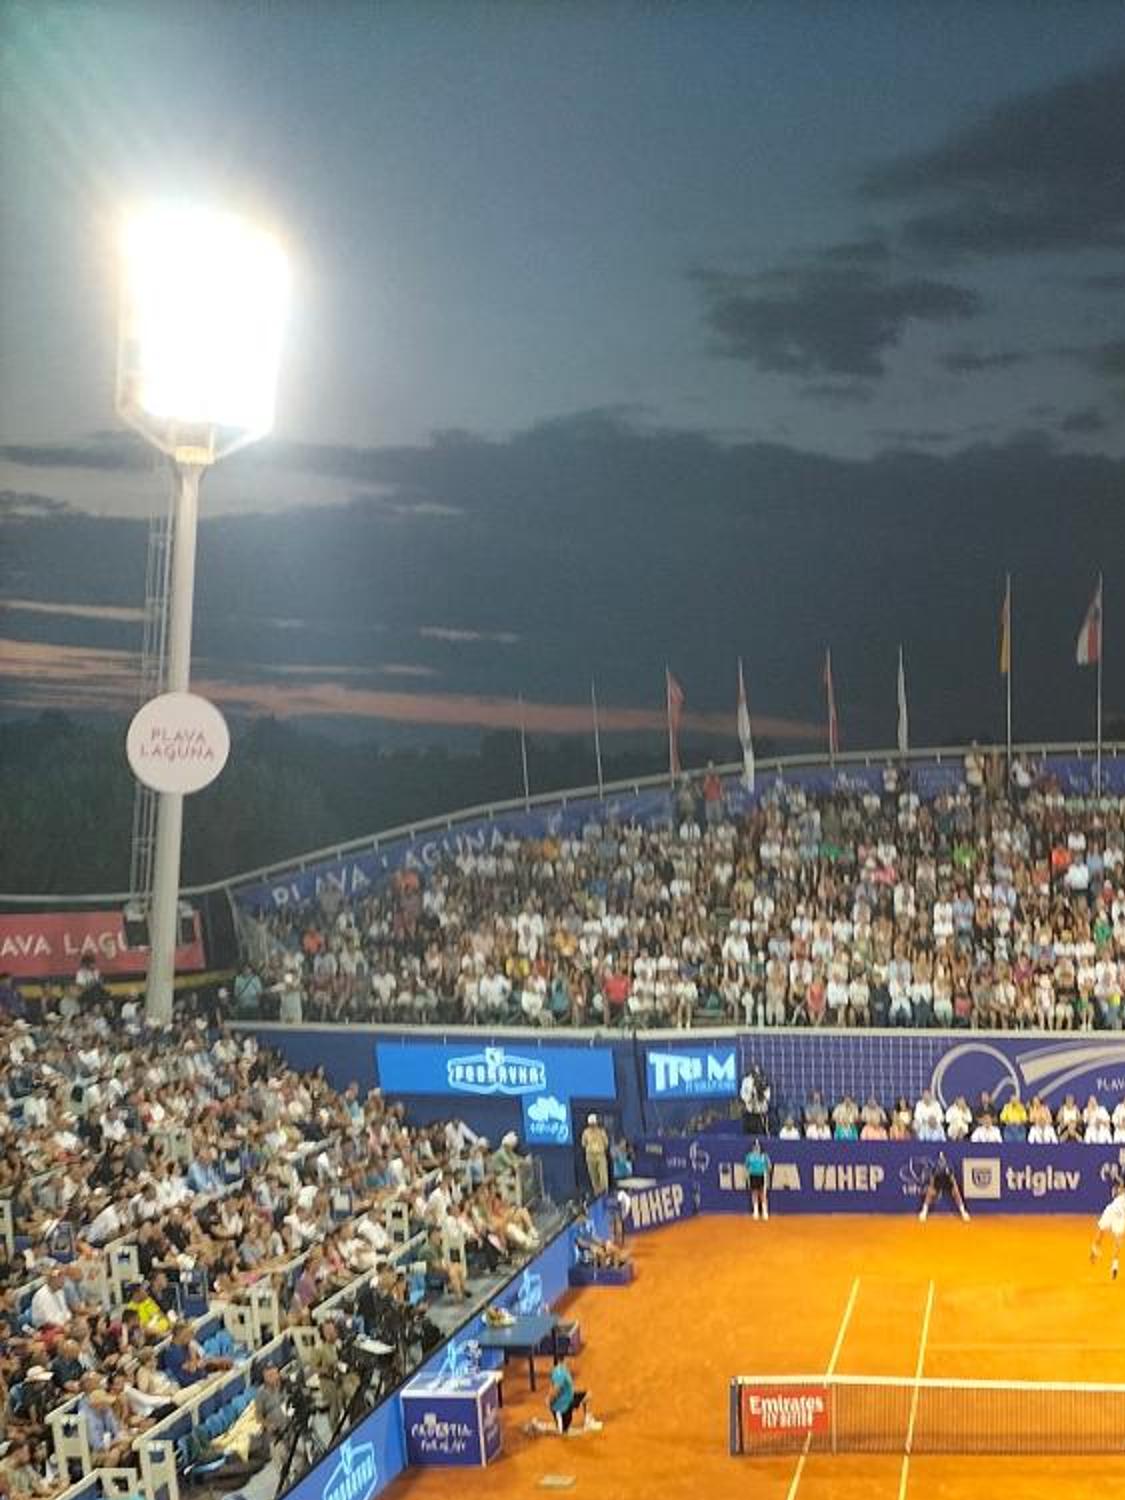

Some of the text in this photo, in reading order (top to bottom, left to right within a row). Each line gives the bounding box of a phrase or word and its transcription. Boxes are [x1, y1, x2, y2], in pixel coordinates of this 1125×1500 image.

[151, 729, 206, 743] PLAVA
[140, 745, 215, 763] LAGUNA
[1005, 1163, 1081, 1196] triglav
[749, 1394, 824, 1416] Emirates
